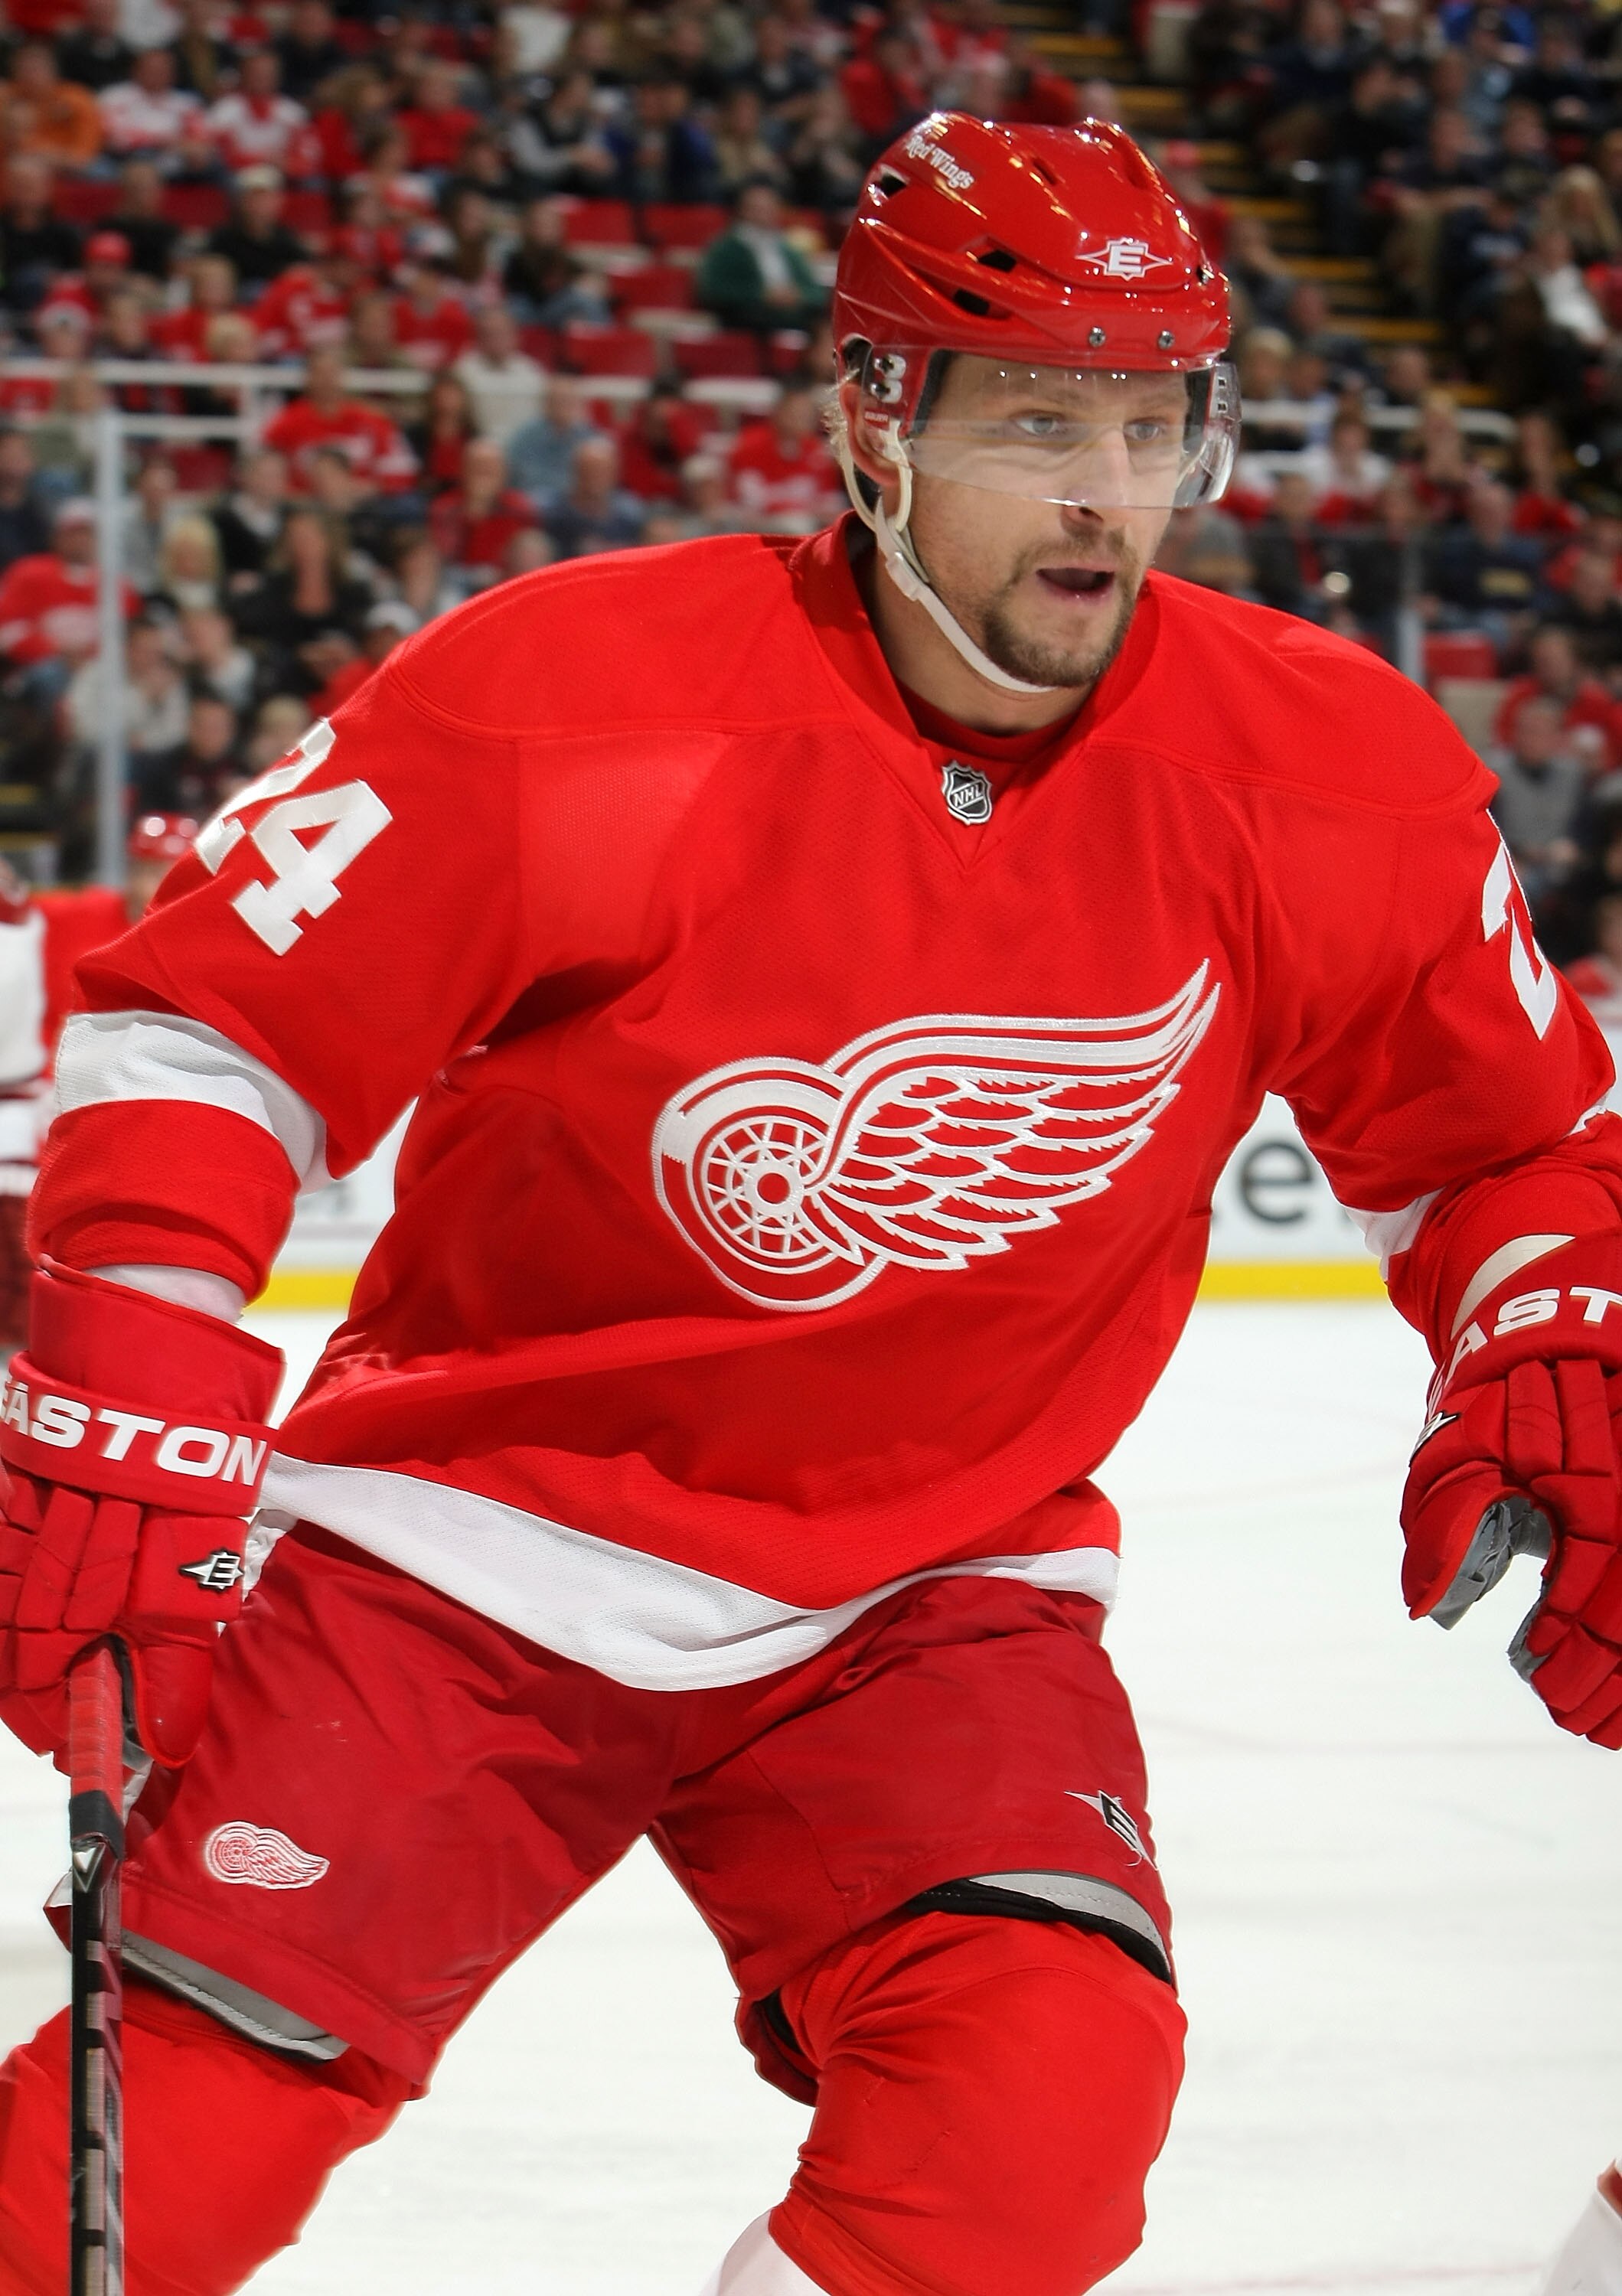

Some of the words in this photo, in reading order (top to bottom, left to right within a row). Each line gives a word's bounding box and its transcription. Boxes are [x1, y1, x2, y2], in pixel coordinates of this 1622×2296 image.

[906, 135, 935, 158] Red
[930, 147, 974, 189] Wings
[954, 784, 983, 807] NHL
[194, 716, 393, 957] 24
